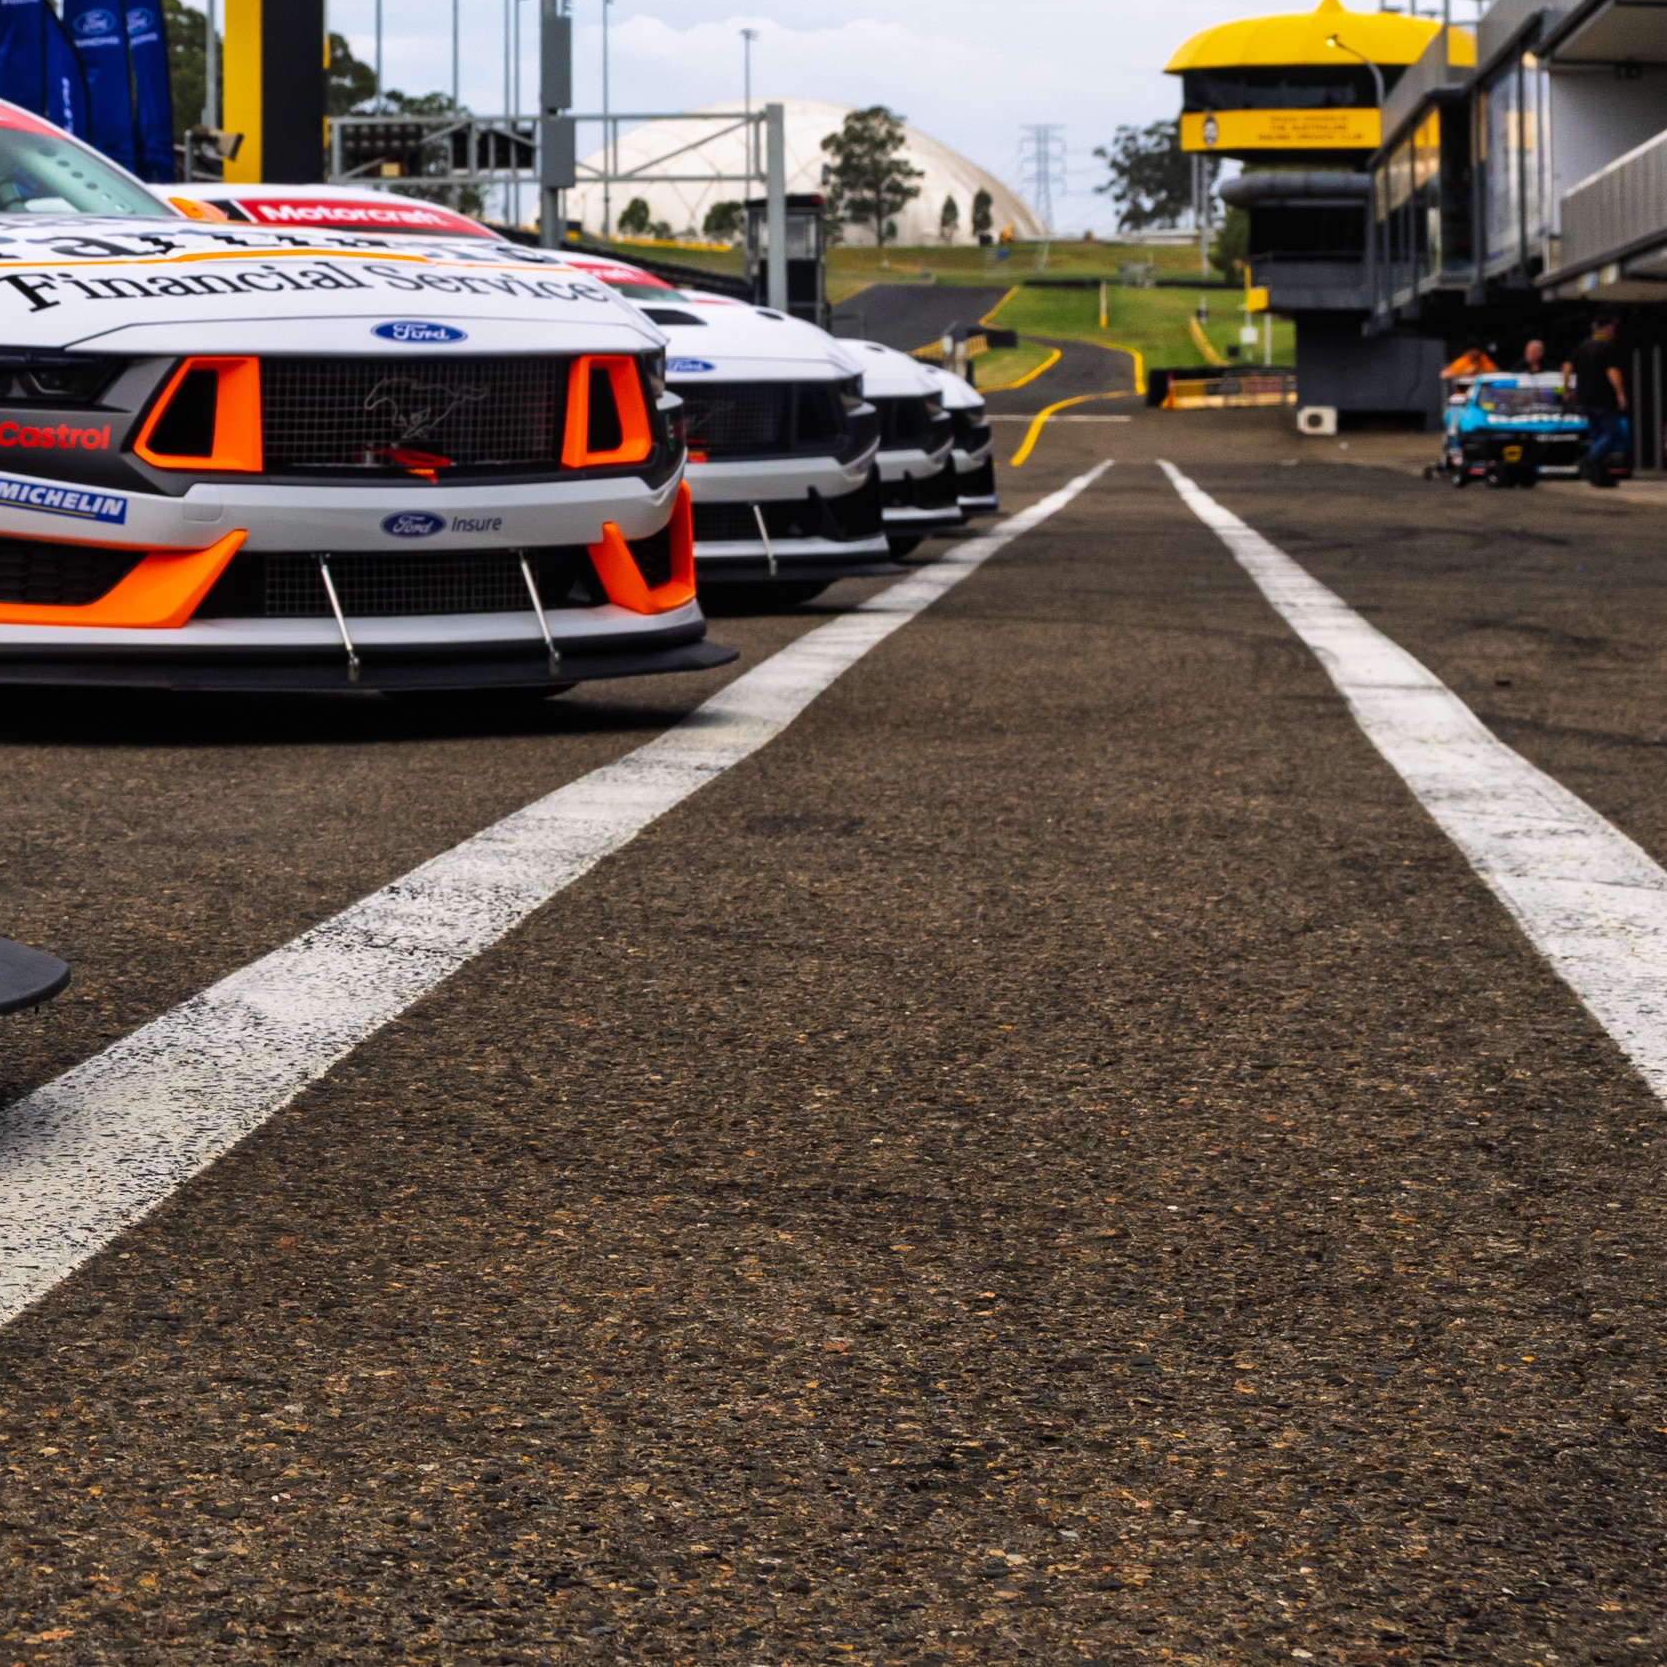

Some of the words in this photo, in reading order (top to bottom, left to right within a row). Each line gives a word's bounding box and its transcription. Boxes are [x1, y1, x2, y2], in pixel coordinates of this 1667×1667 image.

[259, 204, 449, 227] Motorcraft
[393, 323, 450, 341] Ford
[392, 515, 434, 534] Ford
[451, 516, 502, 532] Insure
